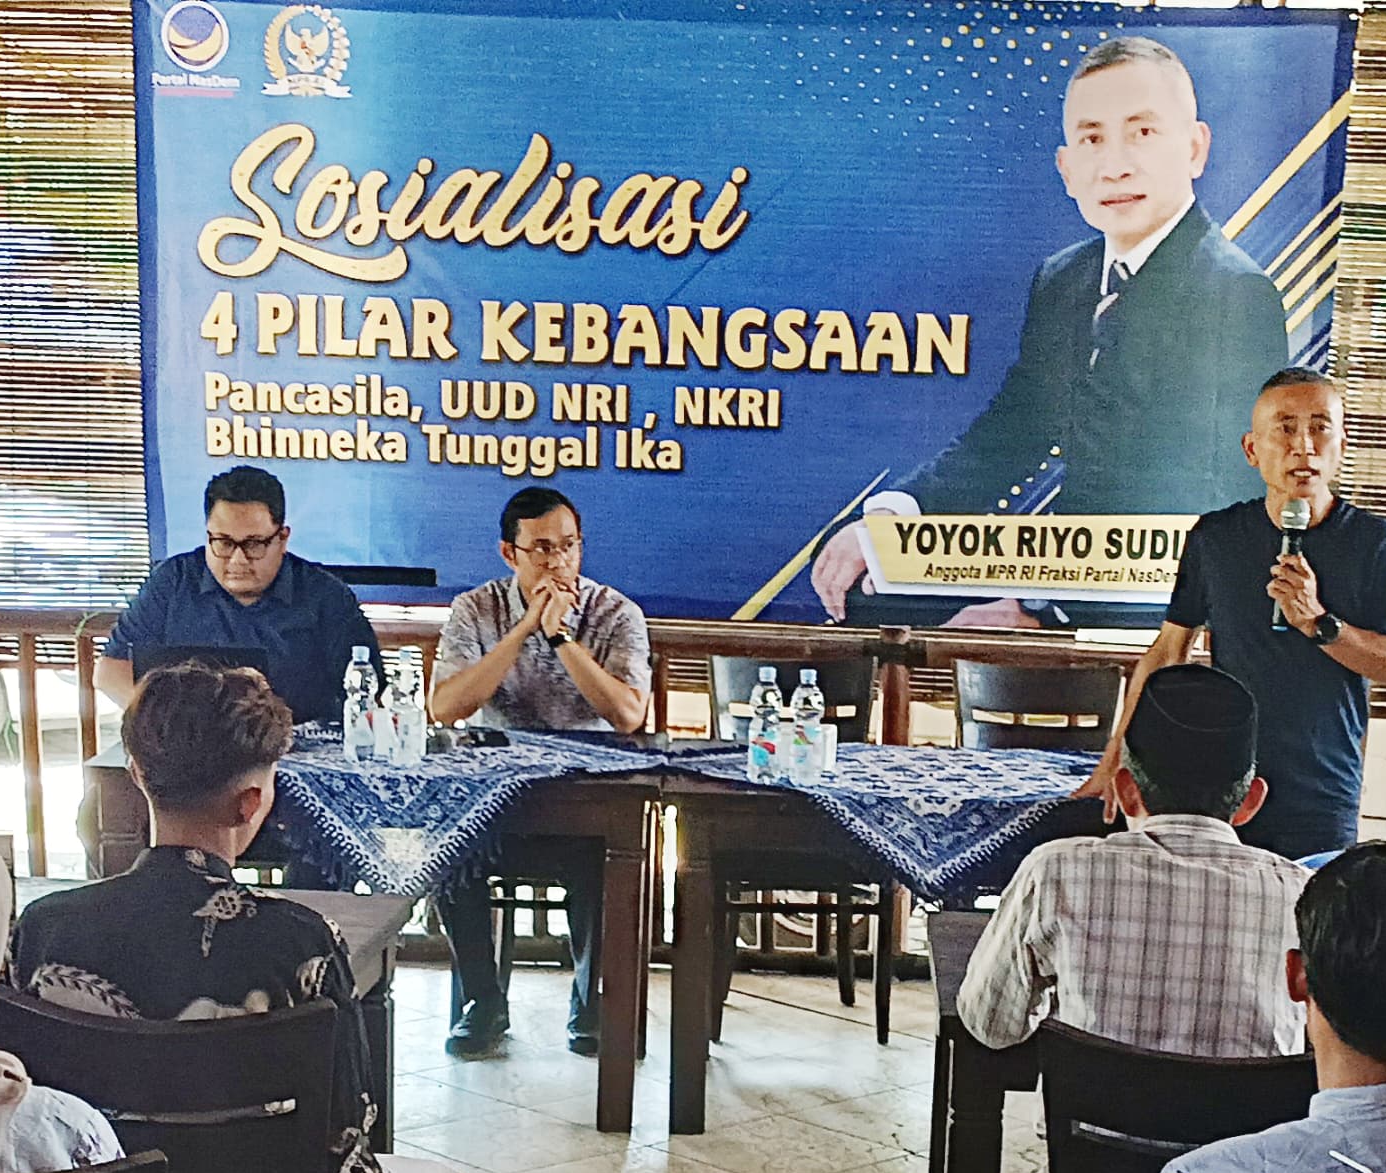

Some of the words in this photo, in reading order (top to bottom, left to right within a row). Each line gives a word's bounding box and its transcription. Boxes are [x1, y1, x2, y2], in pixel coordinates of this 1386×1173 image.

[197, 123, 750, 282] Sosialisasi
[200, 291, 238, 355] 4
[257, 292, 458, 360] PILAR
[481, 300, 969, 374] KEBANGSAAN
[204, 371, 422, 422] Pancasila,
[441, 379, 535, 420] UUD
[675, 387, 780, 427] NKRI
[206, 415, 408, 462] Bhinneka
[421, 424, 597, 476] Tunggal
[616, 428, 682, 470] Ika
[895, 522, 1004, 556] YOYOK
[1017, 525, 1092, 559] RIYO
[1104, 528, 1189, 560] SUDI
[924, 562, 981, 582] Anggota
[985, 564, 1017, 580] MPR
[1020, 565, 1035, 580] RI
[1038, 565, 1081, 581] Fraksi
[1084, 566, 1125, 582] Partai
